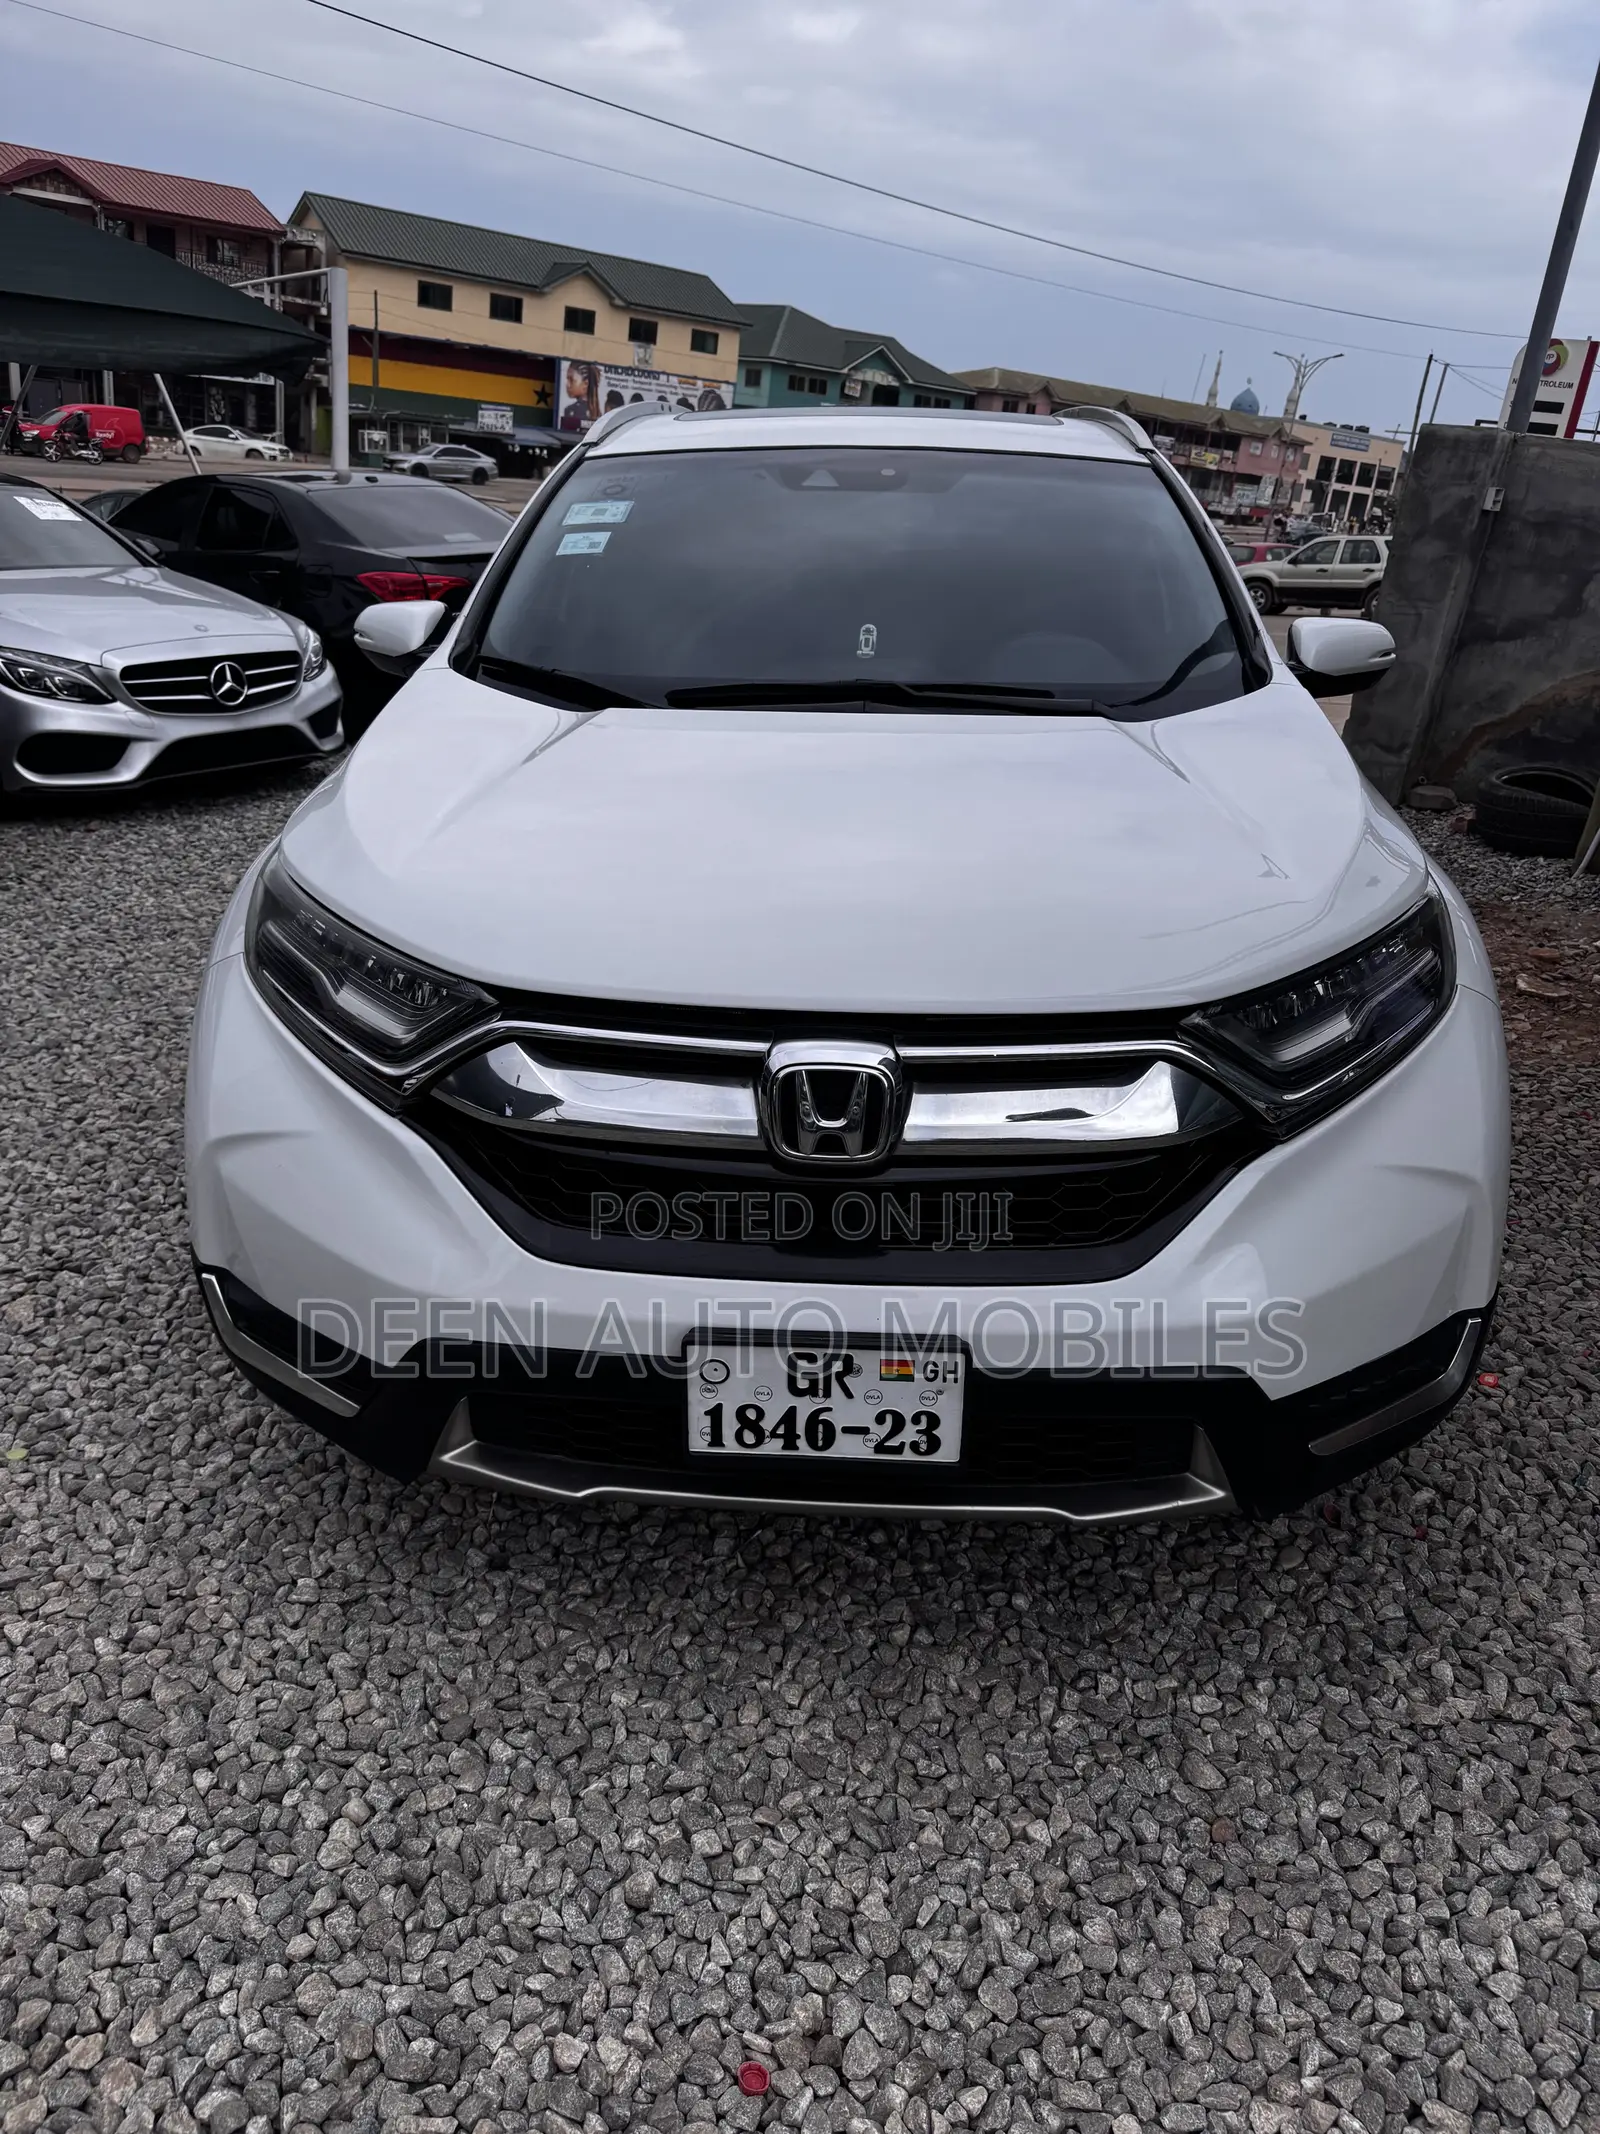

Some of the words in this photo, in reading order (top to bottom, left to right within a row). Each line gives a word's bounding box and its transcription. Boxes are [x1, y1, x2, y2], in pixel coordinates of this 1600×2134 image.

[1540, 380, 1574, 389] TROLEUM
[786, 1351, 856, 1400] GR
[922, 1360, 959, 1384] GH
[703, 1402, 942, 1456] 1846-23
